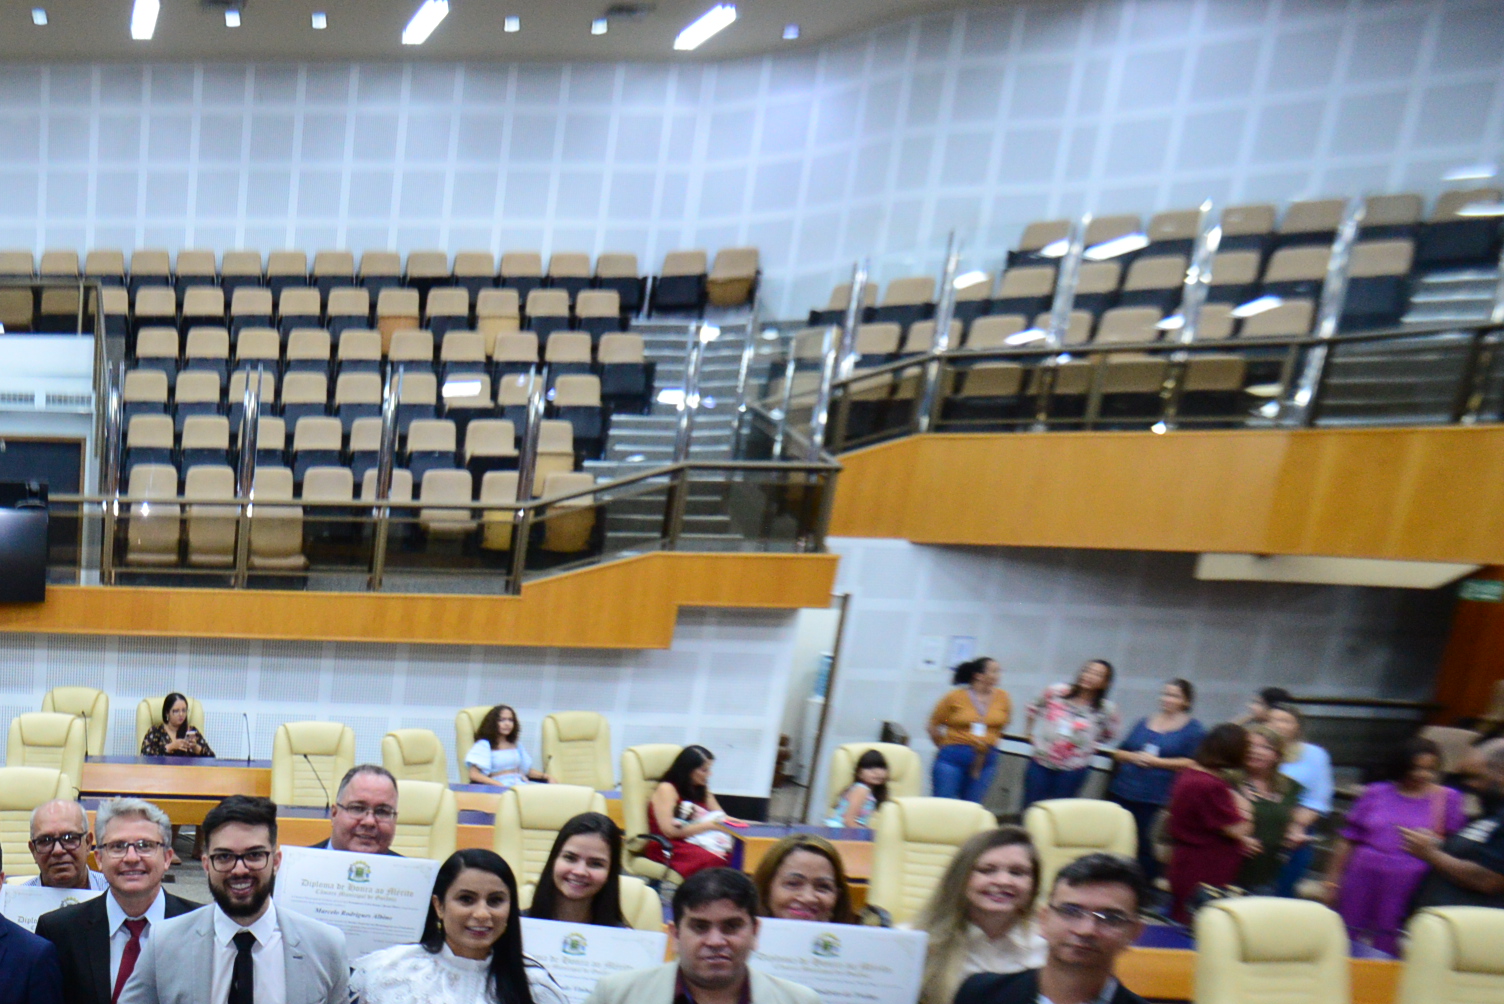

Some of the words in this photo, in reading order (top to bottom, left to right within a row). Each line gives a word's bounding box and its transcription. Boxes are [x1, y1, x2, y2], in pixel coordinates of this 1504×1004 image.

[301, 879, 335, 889] Diploma
[348, 883, 373, 894] Honra
[387, 887, 414, 897] Mérito
[341, 910, 371, 919] Rodrigues
